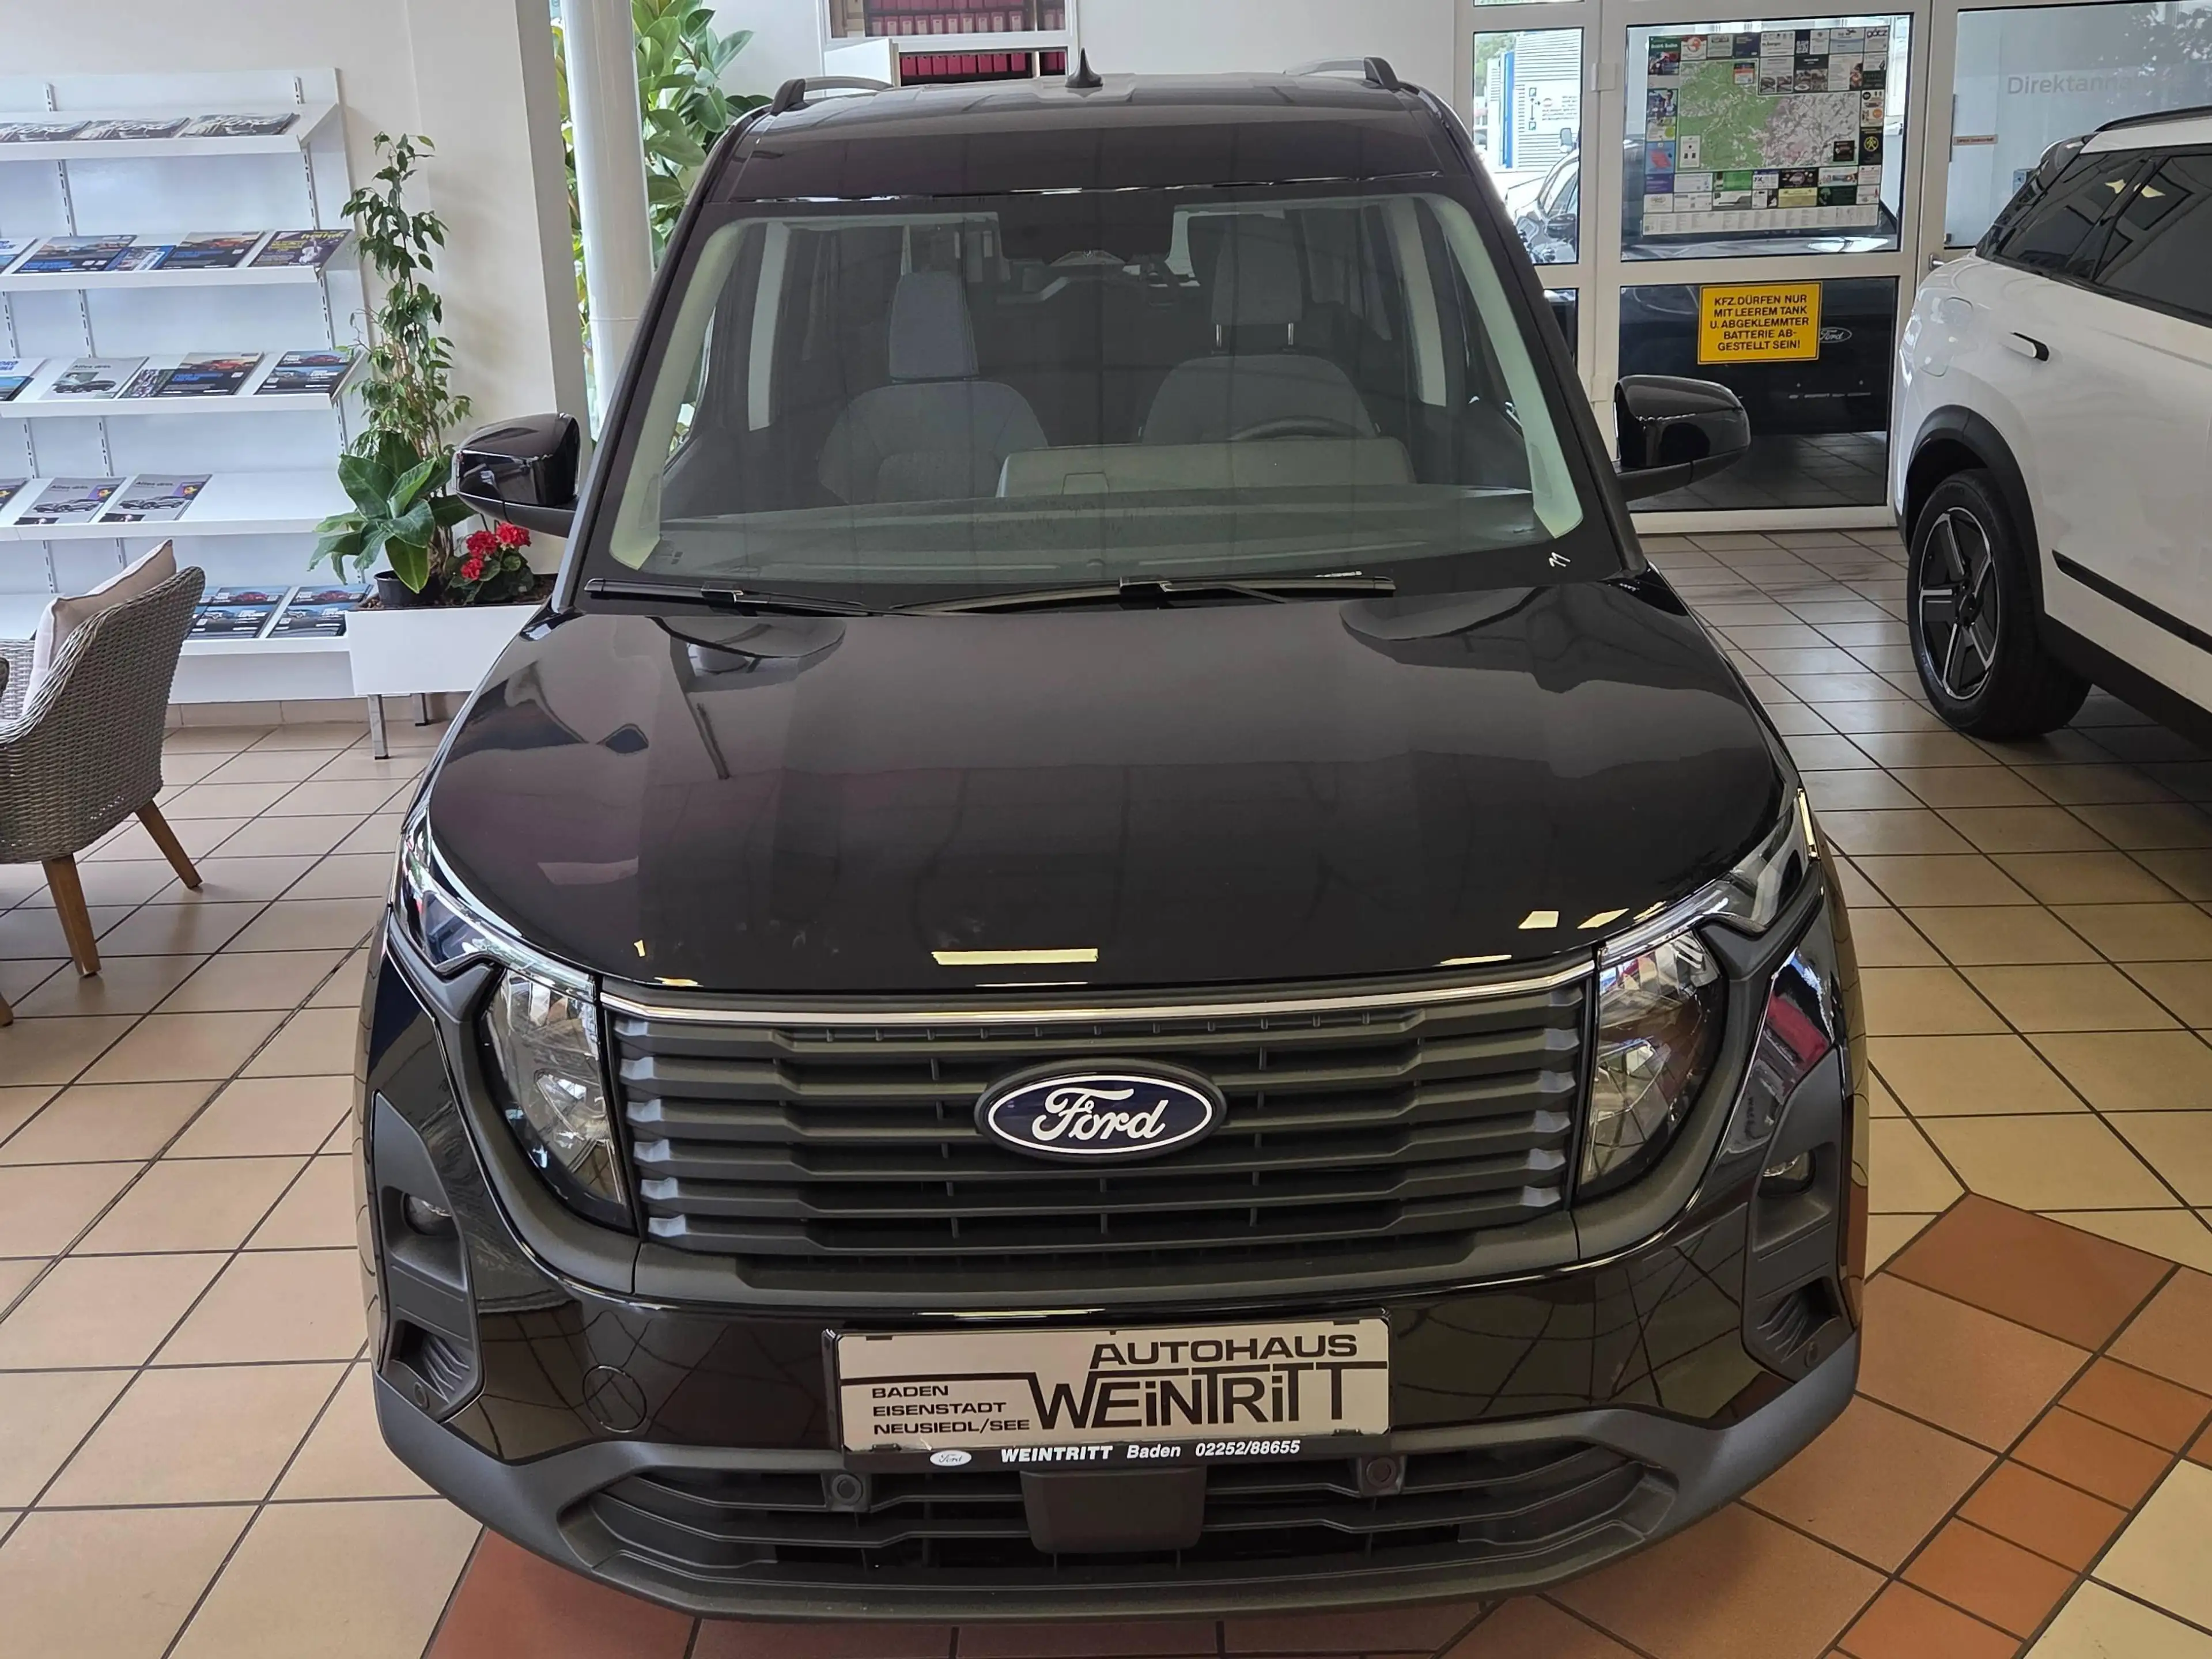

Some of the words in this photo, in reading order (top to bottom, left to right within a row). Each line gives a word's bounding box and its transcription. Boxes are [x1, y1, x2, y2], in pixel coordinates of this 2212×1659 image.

[1737, 294, 1780, 305] DÜRFEN
[1784, 294, 1807, 304] NUR
[1714, 308, 1733, 317] MIT
[1735, 306, 1778, 317] LEEREM
[1780, 305, 1807, 315] TANK
[1710, 320, 1719, 329] U.
[1721, 317, 1809, 328] ABGEKLEMMTER
[1723, 329, 1775, 340] BATTERIE
[1778, 328, 1797, 338] AB-
[1820, 329, 1844, 340] Ford
[1718, 340, 1771, 351] GESTELLT
[1772, 340, 1800, 350] SEIN!
[1031, 1087, 1169, 1141] Ford
[1090, 1334, 1358, 1369] AUTOHAUS
[871, 1385, 949, 1399] BADEN
[872, 1402, 1007, 1417] EISENSTADT
[873, 1418, 1030, 1435] NEUSIEDL/SEE
[1001, 1445, 1113, 1463] WEINTRITT
[1126, 1444, 1181, 1460] Baden
[1195, 1440, 1301, 1457] 02252/88655
[939, 1453, 963, 1464] Ford
